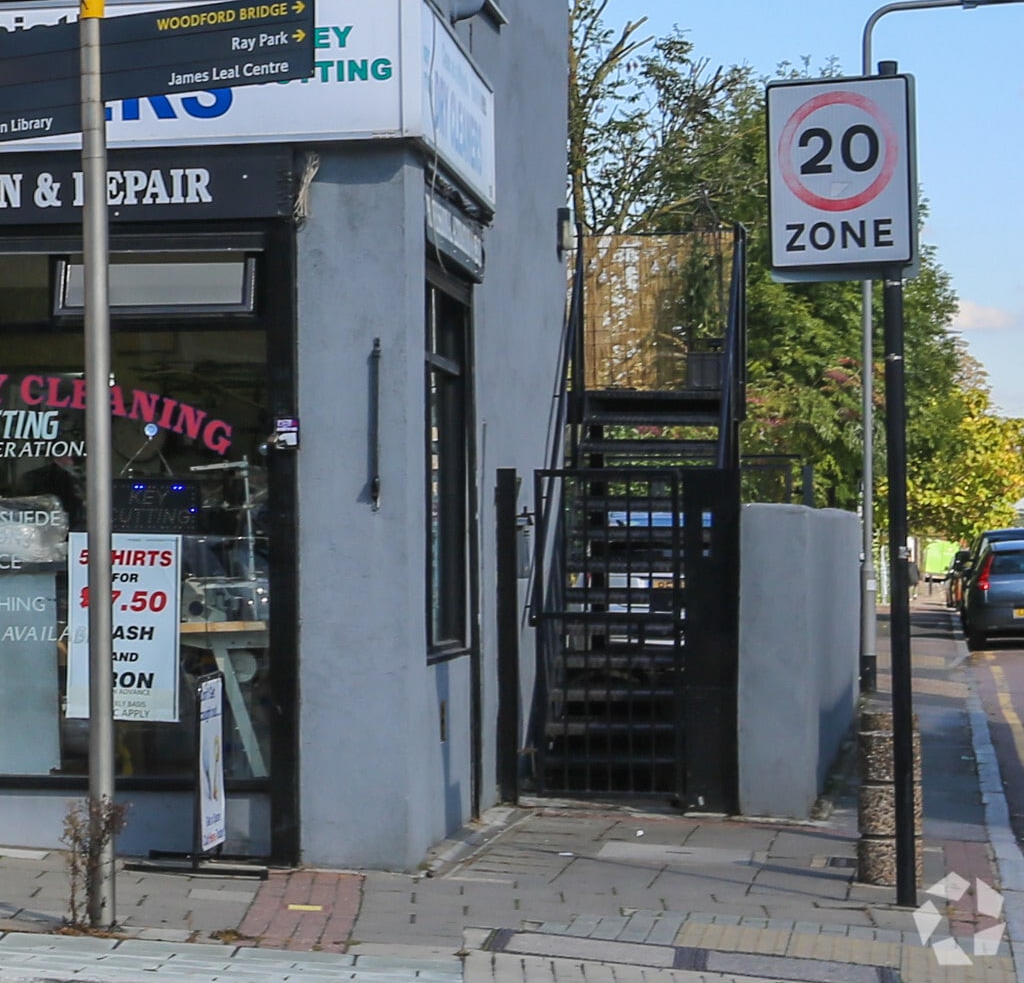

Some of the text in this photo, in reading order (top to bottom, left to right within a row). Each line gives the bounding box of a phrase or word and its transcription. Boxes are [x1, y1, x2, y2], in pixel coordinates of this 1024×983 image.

[157, 3, 288, 31] WOODFORD BRIDGE
[231, 30, 288, 52] Ray Park
[314, 26, 353, 48] EY
[168, 60, 289, 86] James Leal Centre
[8, 116, 54, 134] Library
[798, 124, 880, 175] 20
[33, 172, 62, 208] &
[73, 167, 213, 207] EPAIR
[785, 218, 894, 252] ZONE
[0, 510, 61, 527] SUEDE
[112, 550, 173, 567] HIRTS
[112, 573, 139, 583] FOR
[112, 625, 155, 641] ASH
[121, 708, 151, 719] APPLY
